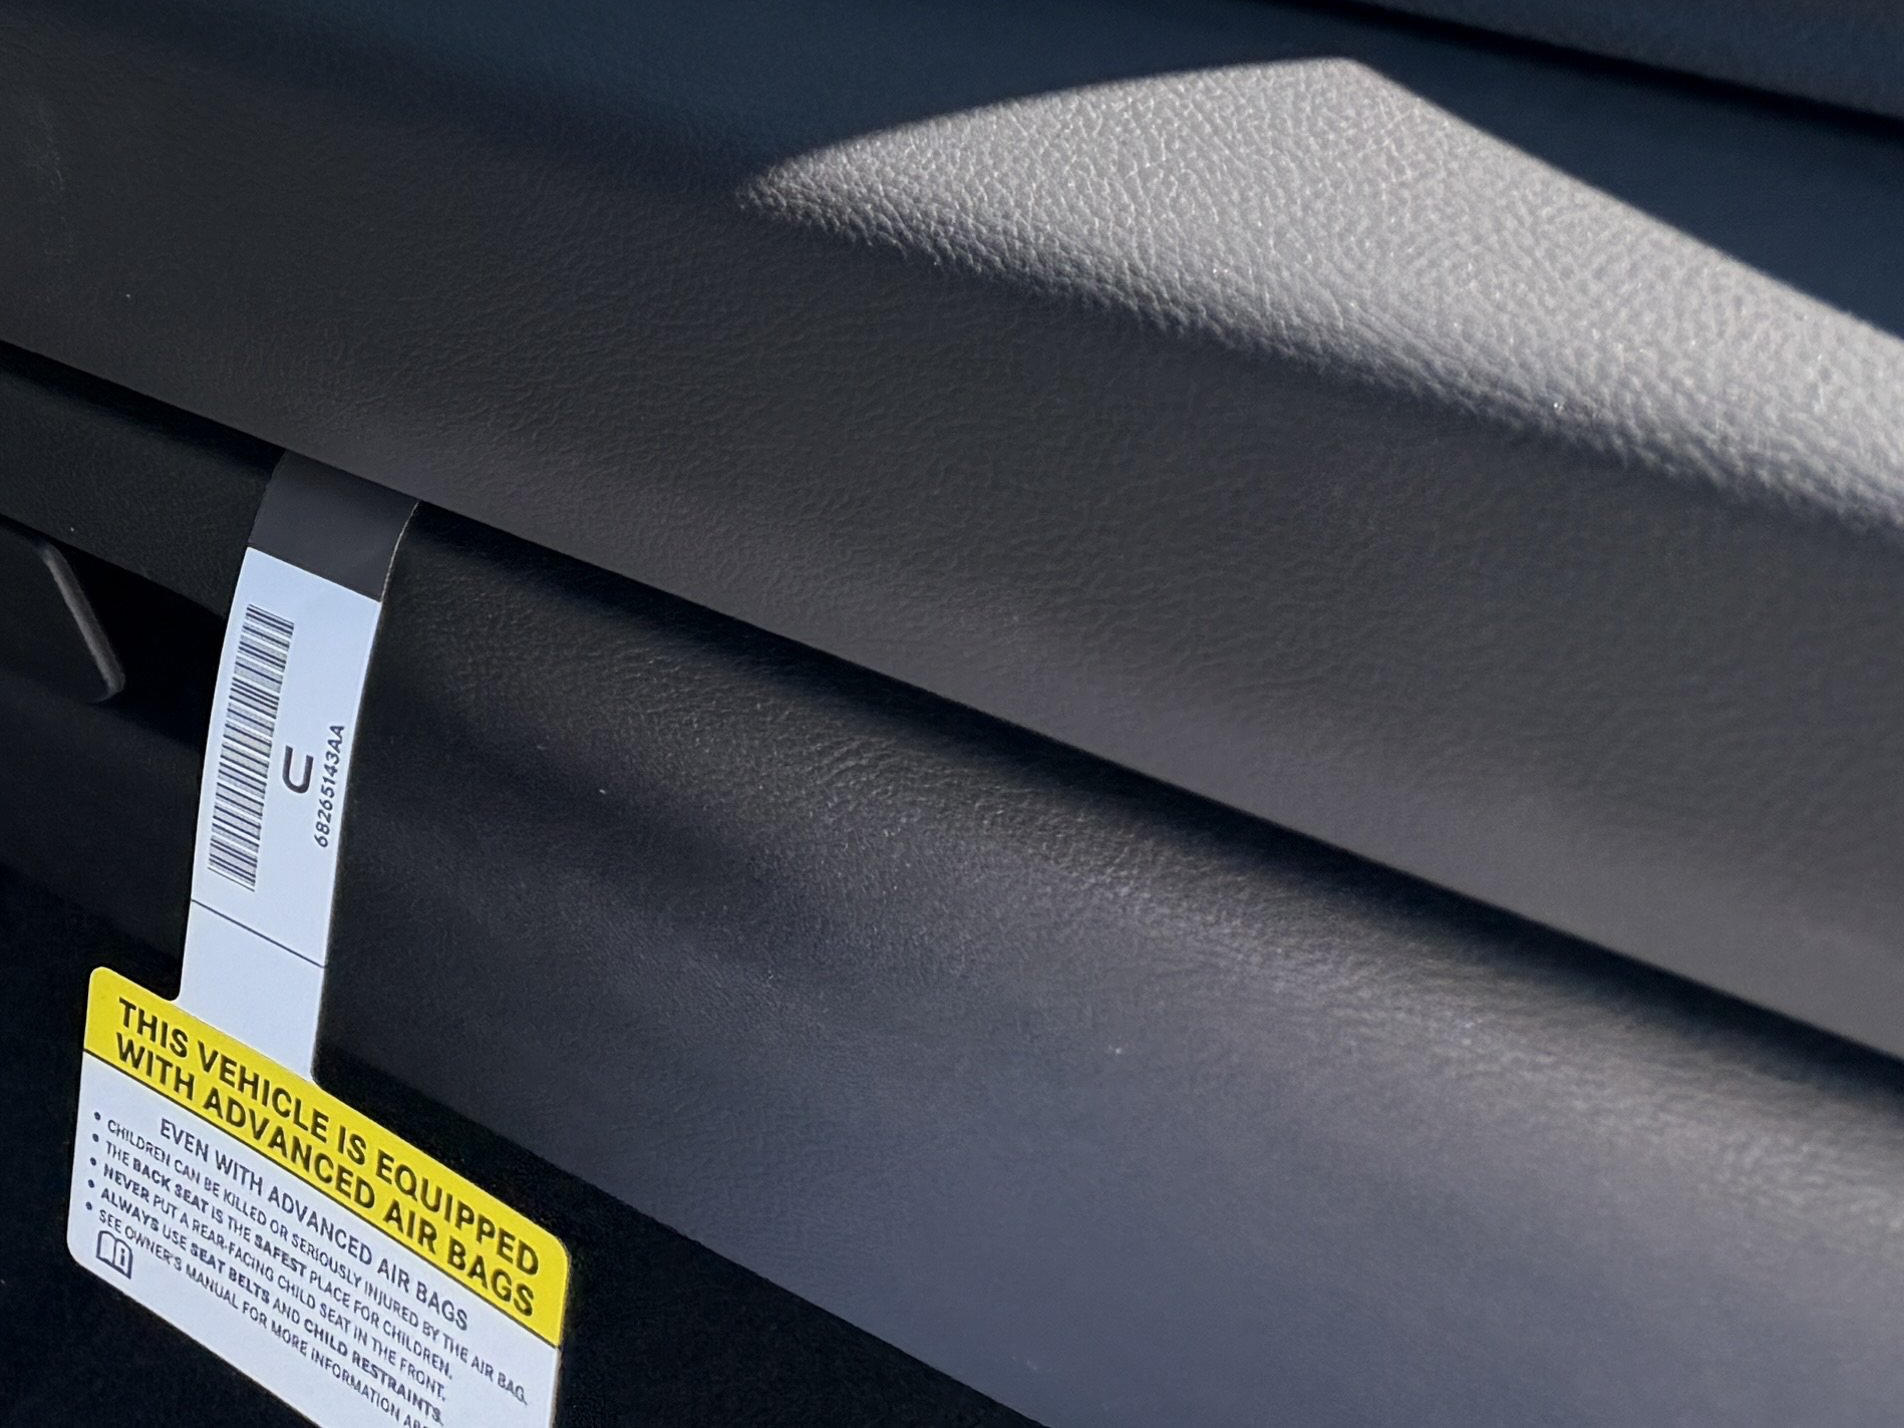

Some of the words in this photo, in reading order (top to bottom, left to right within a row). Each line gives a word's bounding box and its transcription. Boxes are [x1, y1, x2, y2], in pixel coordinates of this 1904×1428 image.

[282, 745, 313, 794] U
[314, 725, 345, 848] 68265143AA
[105, 1139, 130, 1167] THE
[132, 1156, 171, 1192] BACK
[173, 1182, 209, 1214] SEAT
[210, 1205, 223, 1224] IS
[227, 1214, 251, 1243] THE
[253, 1233, 307, 1278] SAFEST
[308, 1269, 351, 1309] PLACE
[352, 1298, 380, 1329] FOR
[115, 1031, 195, 1101] WITH
[200, 1086, 375, 1216] ADVANCED
[382, 1198, 437, 1255] AIR
[446, 1235, 534, 1317] BAGS
[118, 996, 188, 1058] THIS
[196, 1039, 329, 1144] VEHICLE
[336, 1124, 367, 1166] IS
[374, 1148, 539, 1276] EQUIPPED
[159, 1117, 209, 1163] EVEN
[214, 1148, 263, 1197] WITH
[266, 1184, 372, 1265] ADVANCED
[376, 1257, 410, 1294] AIR
[415, 1280, 468, 1331] BAGS
[98, 1208, 122, 1234] SEE
[123, 1224, 182, 1272] OWNER'S
[185, 1262, 239, 1310] MANUAL
[241, 1299, 267, 1329] FOR
[270, 1319, 308, 1357] MORE
[310, 1346, 400, 1422] INFORMATION
[100, 1186, 159, 1232] ALWAYS
[161, 1223, 187, 1251] USE
[189, 1241, 226, 1274] SEAT
[227, 1265, 270, 1304] BELTS
[271, 1296, 300, 1325] AND
[303, 1317, 348, 1357] CHILD
[102, 1162, 150, 1203] NEVER
[152, 1193, 178, 1219] PUT
[178, 1211, 189, 1229] A
[191, 1217, 274, 1282] REAR-FACING
[276, 1274, 316, 1310] CHILD
[318, 1301, 351, 1334] SEAT
[352, 1324, 368, 1346] IN
[371, 1336, 397, 1366] THE
[106, 1118, 171, 1167] CHILDREN
[173, 1158, 200, 1185] CAN
[203, 1175, 220, 1198] BE
[222, 1187, 267, 1226] KILLED
[268, 1218, 288, 1242] OR
[290, 1232, 362, 1288] SERIOUSLY
[363, 1280, 419, 1328] INJURED
[421, 1319, 440, 1342] BY
[442, 1332, 469, 1364] THE
[470, 1355, 494, 1382] AIR
